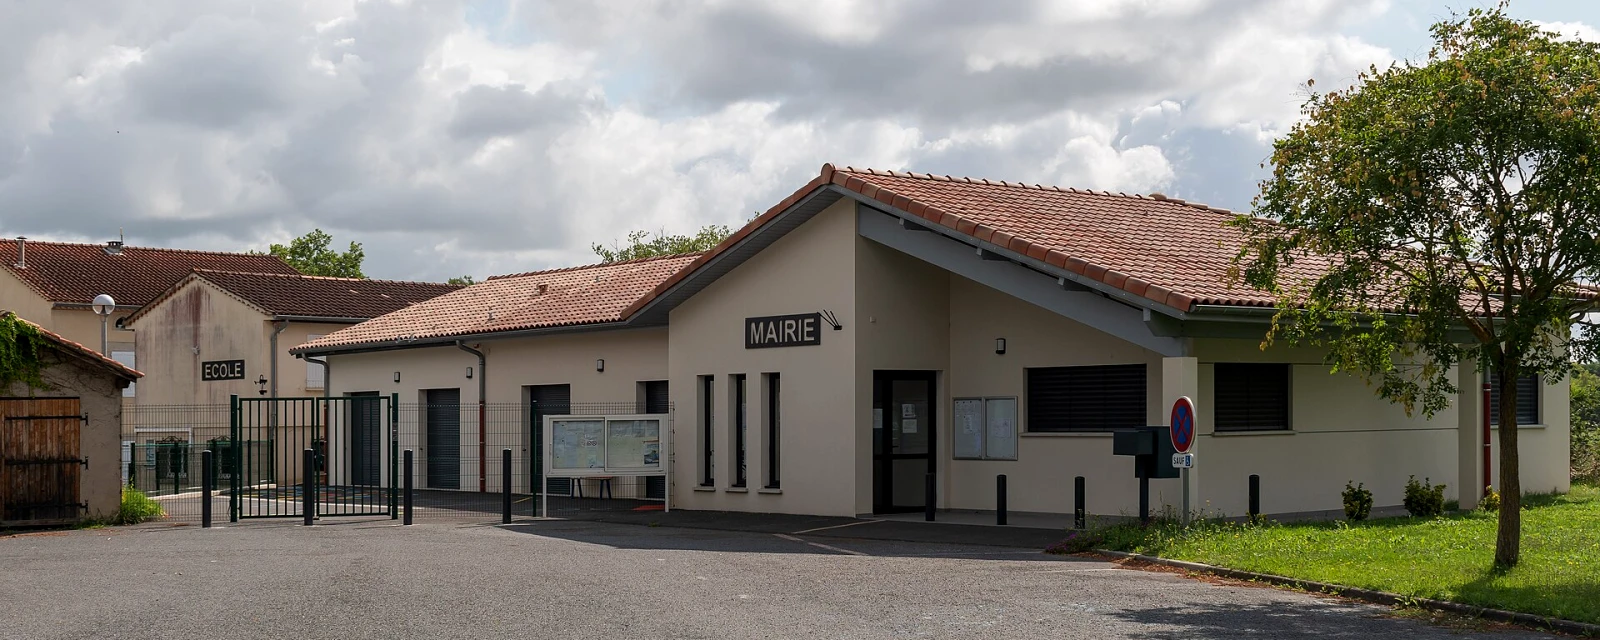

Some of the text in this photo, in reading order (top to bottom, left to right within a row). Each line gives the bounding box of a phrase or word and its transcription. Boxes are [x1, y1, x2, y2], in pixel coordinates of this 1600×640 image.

[750, 318, 815, 344] MAIRIE
[205, 363, 241, 378] ECOLE
[1173, 456, 1185, 465] SAUF
